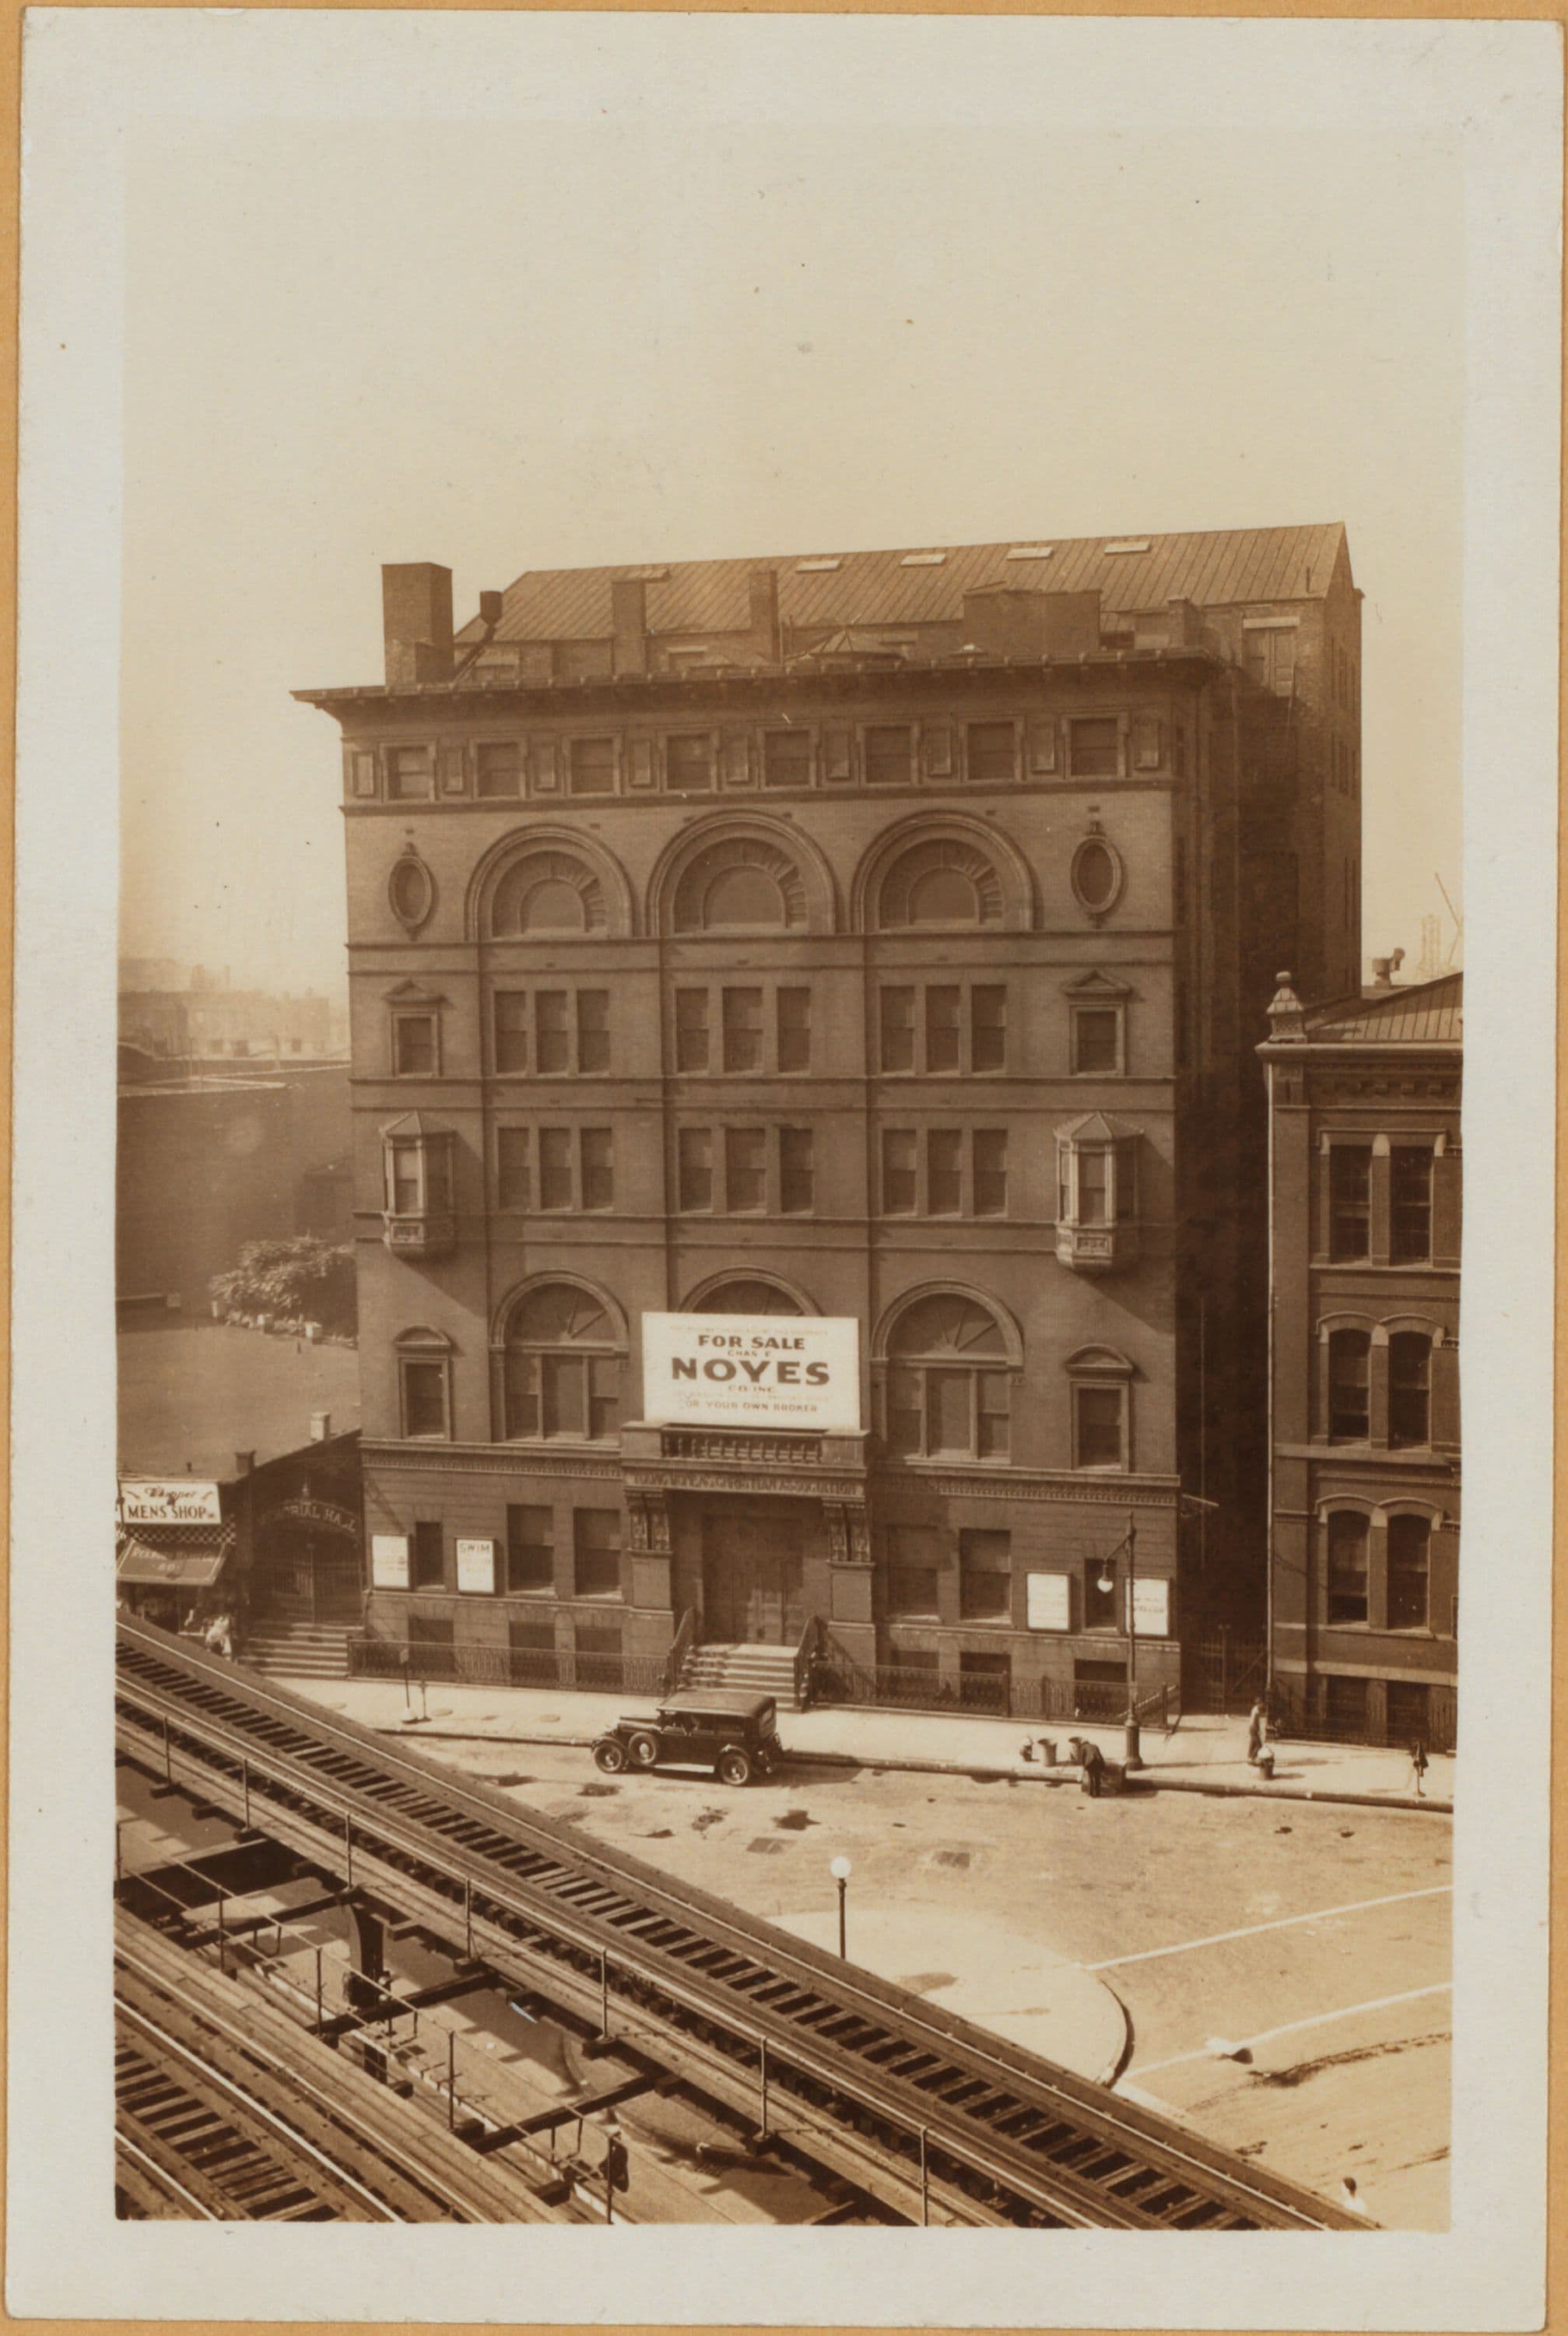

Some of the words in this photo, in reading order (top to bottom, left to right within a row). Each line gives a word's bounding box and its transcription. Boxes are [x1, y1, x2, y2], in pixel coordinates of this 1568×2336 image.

[698, 1335, 742, 1350] FOR
[751, 1335, 805, 1351] SALE
[728, 1350, 759, 1358] CHAS
[671, 1357, 830, 1386] NOYES
[706, 1401, 738, 1410] YOUR
[742, 1402, 769, 1411] OWN
[773, 1403, 818, 1414] BROKER
[128, 1505, 167, 1519] MENS
[171, 1505, 207, 1519] SHOP
